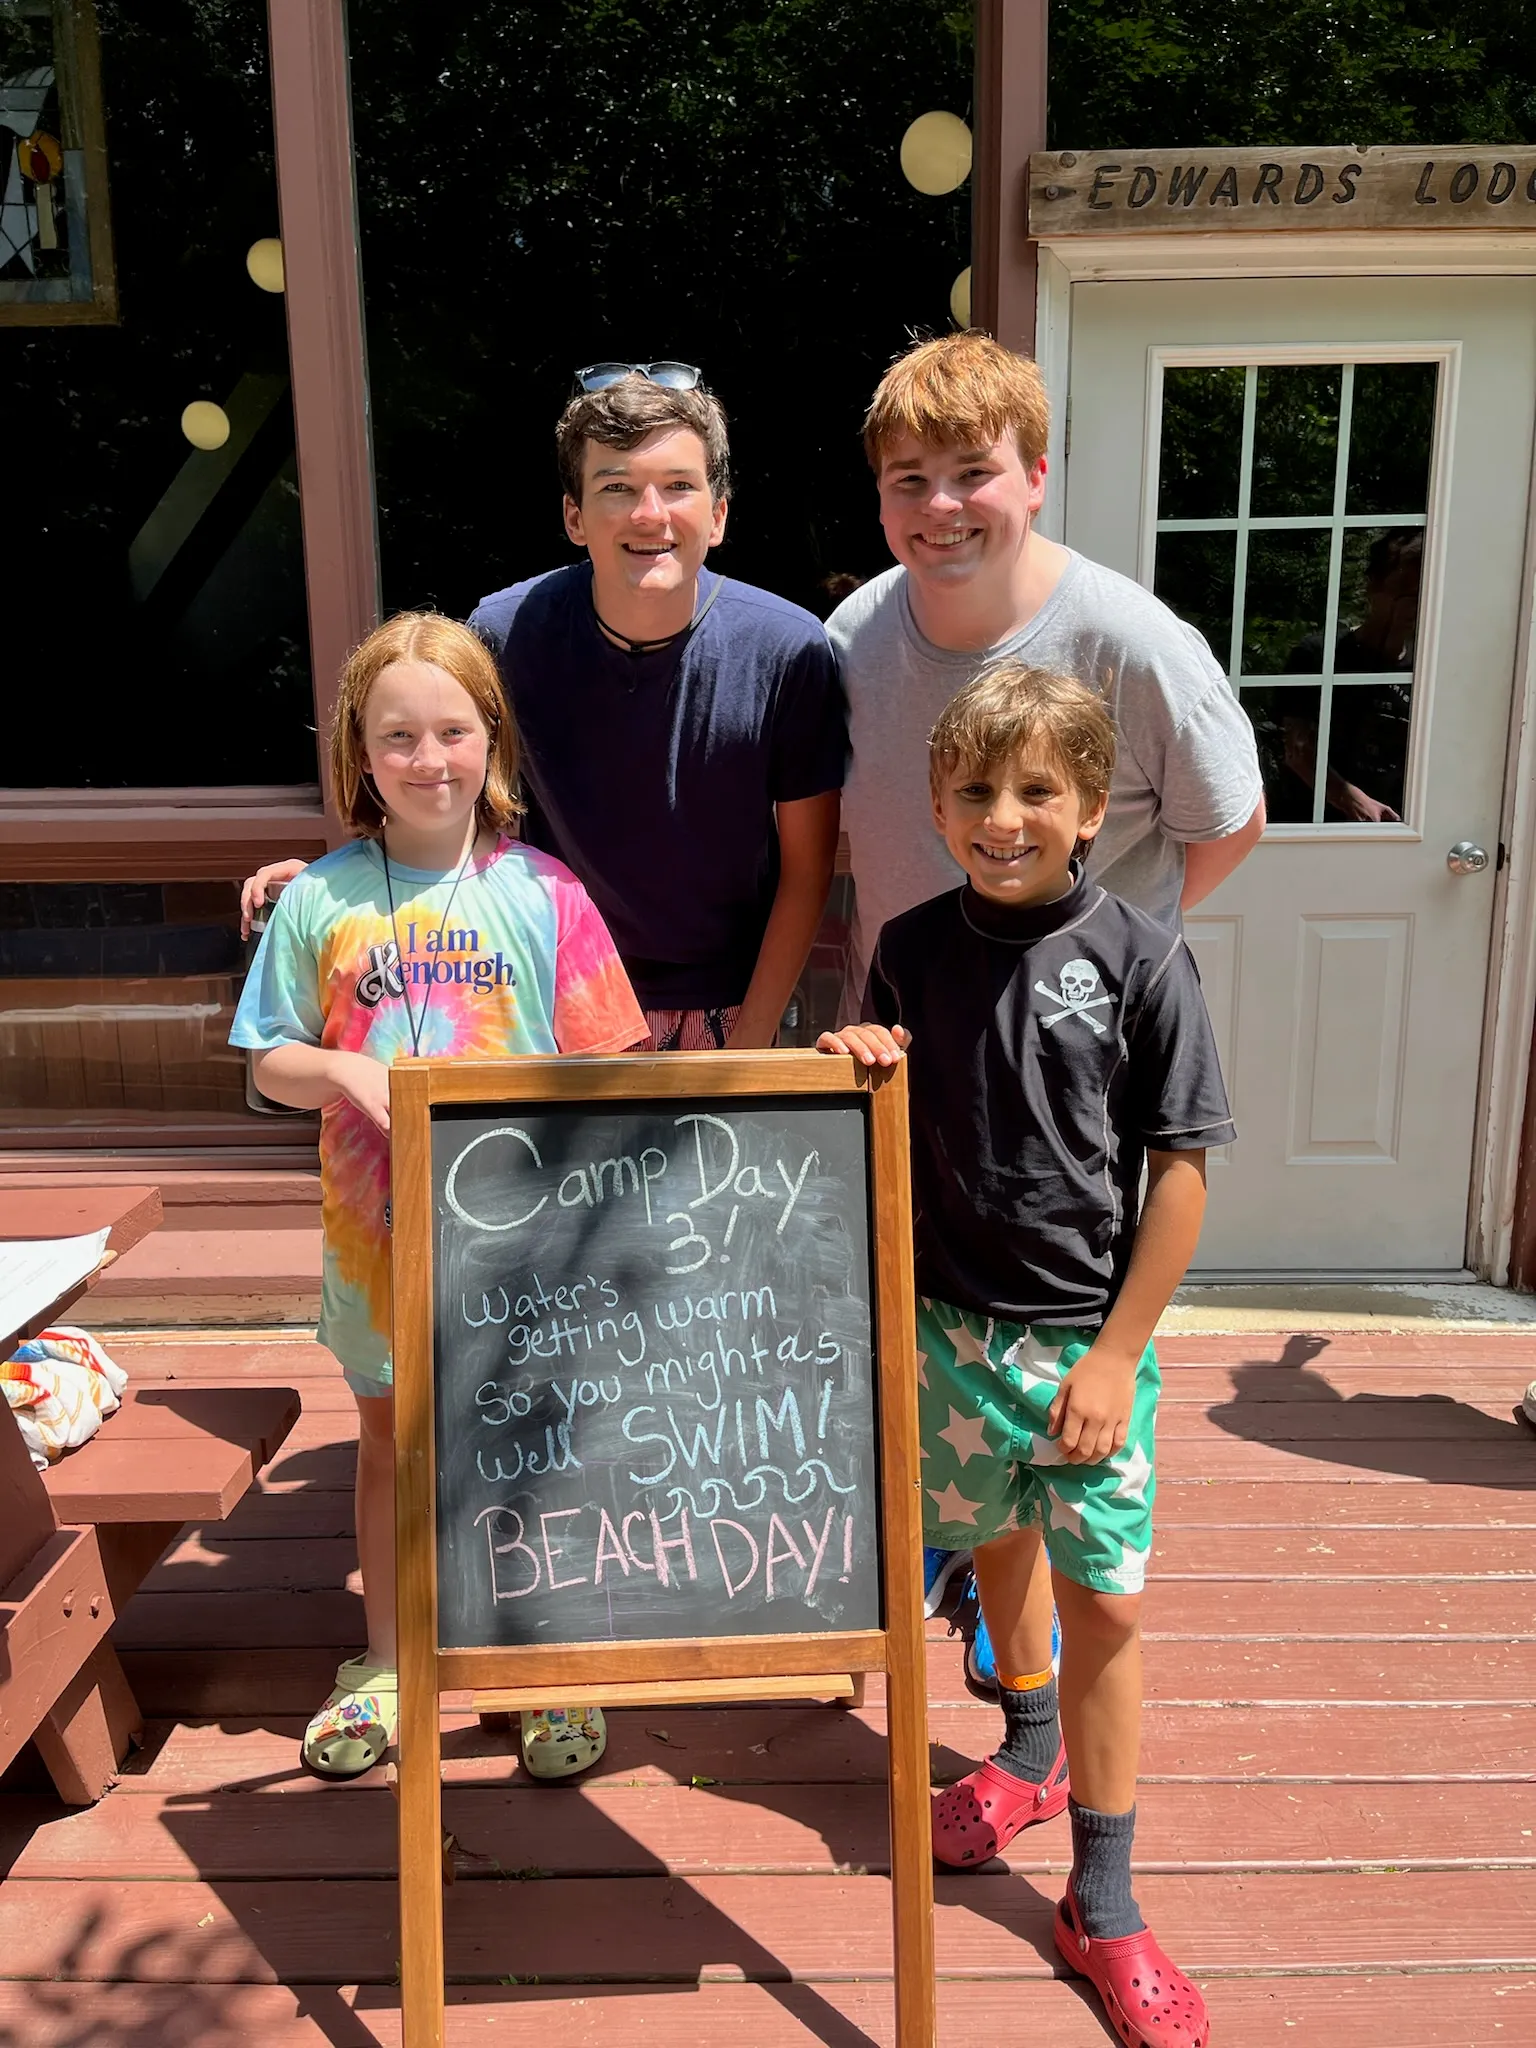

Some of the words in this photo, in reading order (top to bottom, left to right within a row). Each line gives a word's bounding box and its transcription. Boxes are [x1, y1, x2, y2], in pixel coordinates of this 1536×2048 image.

[1087, 163, 1362, 209] EDWARDS
[355, 940, 517, 1010] Kenough.
[406, 922, 418, 954] I
[425, 927, 479, 953] am
[444, 1126, 668, 1231] Camp
[673, 1113, 820, 1235] Day
[664, 1204, 740, 1275] 3!
[508, 1309, 647, 1367] getting
[654, 1285, 778, 1331] warm
[550, 1374, 623, 1426] you
[644, 1328, 770, 1411] might
[776, 1331, 842, 1365] as
[621, 1375, 837, 1485] SWIM!
[473, 1505, 699, 1607] BEACH
[709, 1504, 854, 1600] DAY!
